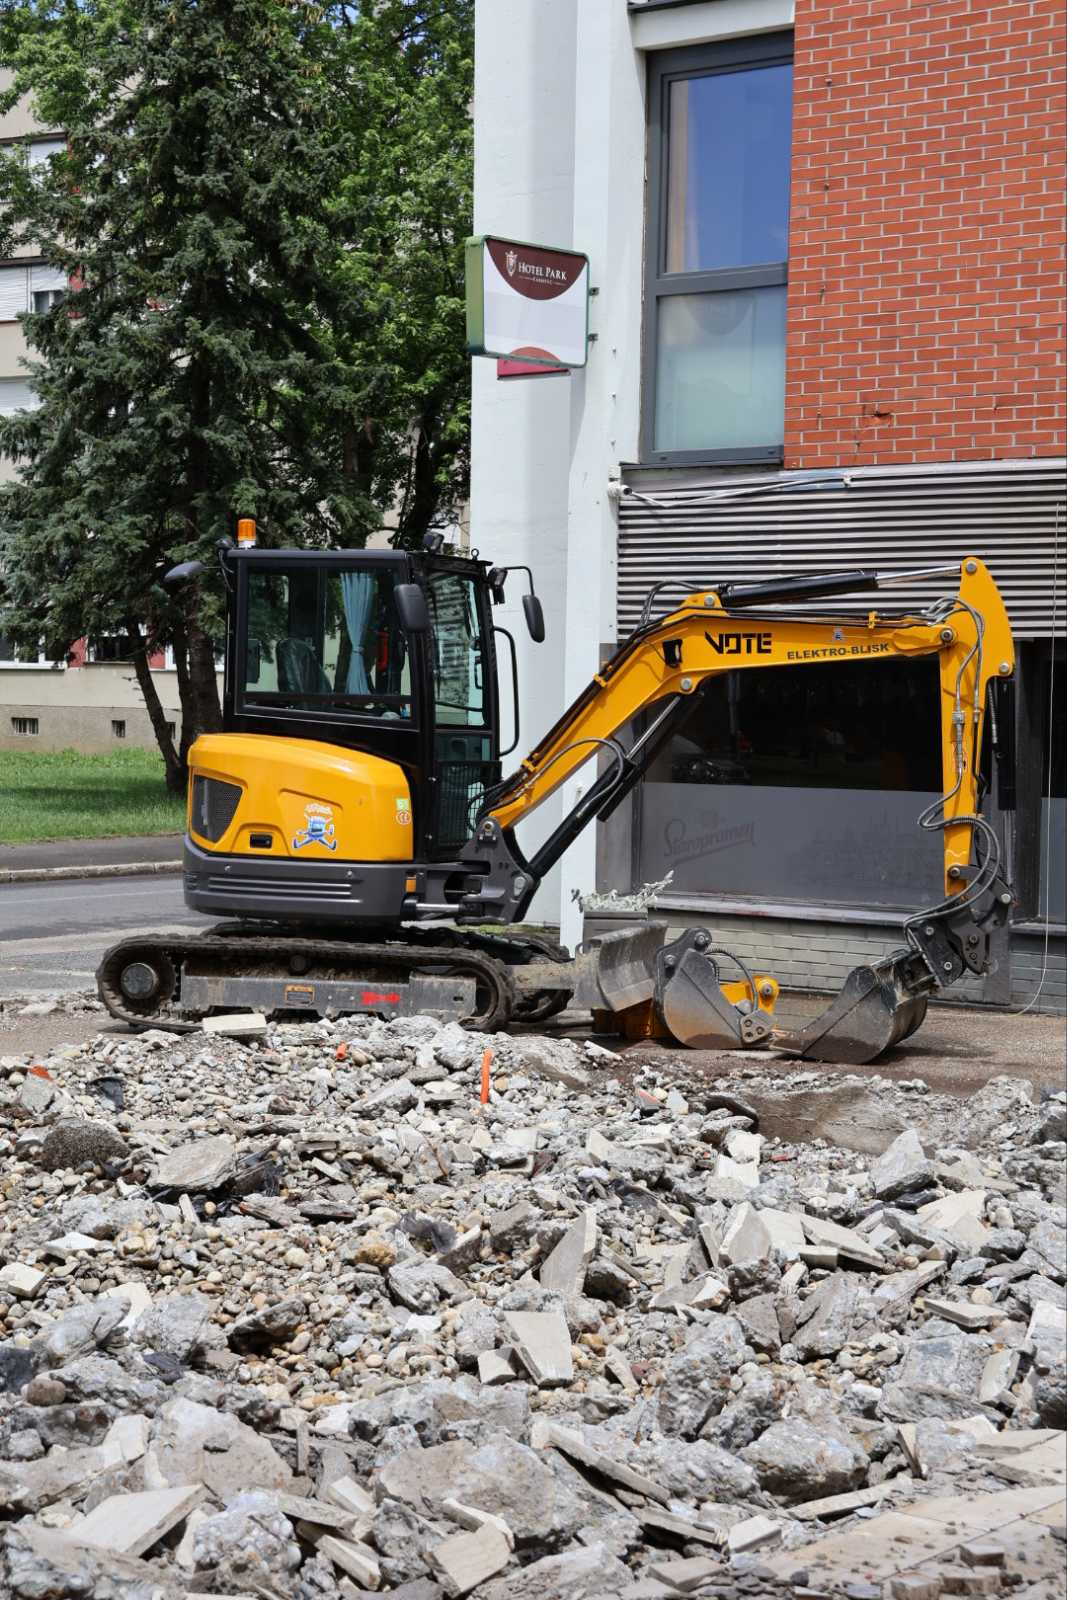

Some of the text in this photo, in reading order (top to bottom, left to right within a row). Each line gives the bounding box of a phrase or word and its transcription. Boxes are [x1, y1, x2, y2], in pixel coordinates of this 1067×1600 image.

[518, 262, 567, 280] HOTEL PARK
[704, 631, 772, 654] VOTE
[787, 643, 890, 660] ELEKTRO-BLISK
